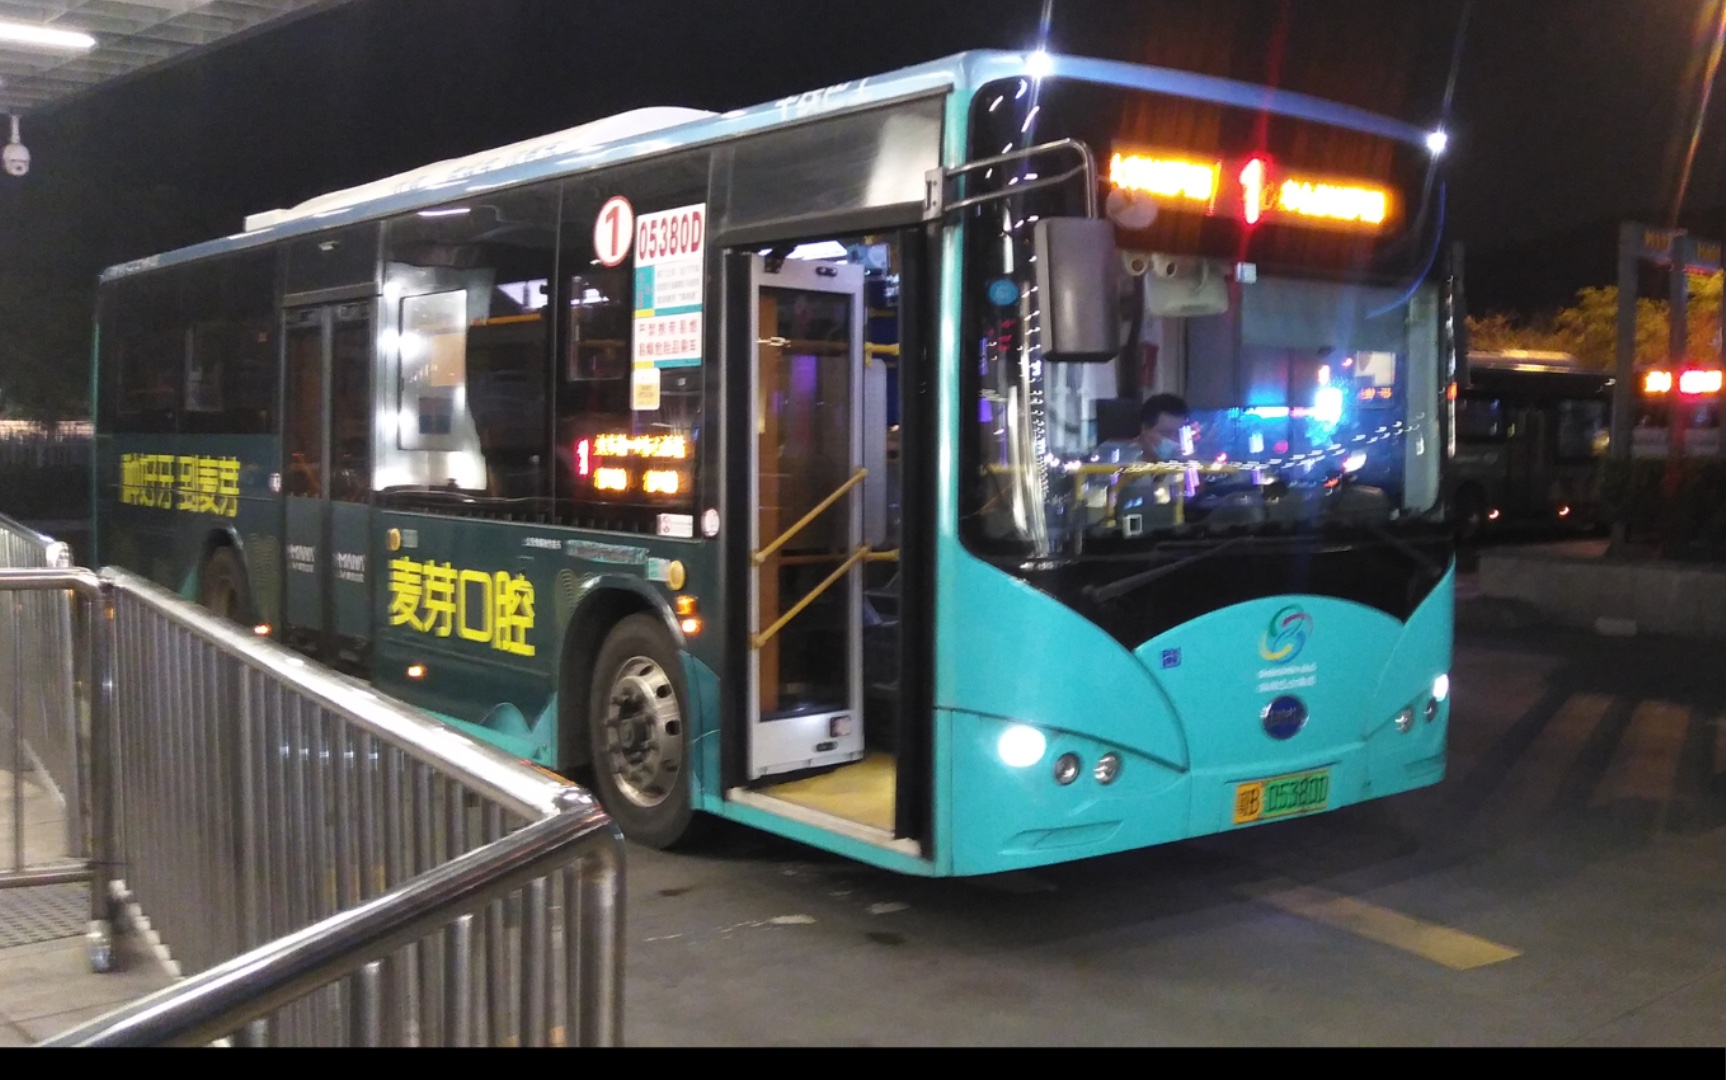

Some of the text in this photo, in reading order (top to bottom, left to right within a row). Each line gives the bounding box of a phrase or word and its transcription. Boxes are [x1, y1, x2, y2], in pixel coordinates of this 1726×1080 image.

[1239, 157, 1265, 225] 1
[604, 204, 621, 257] 1
[638, 210, 703, 260] 05380D
[576, 439, 590, 476] 1
[387, 556, 536, 657] 麦芽口腔
